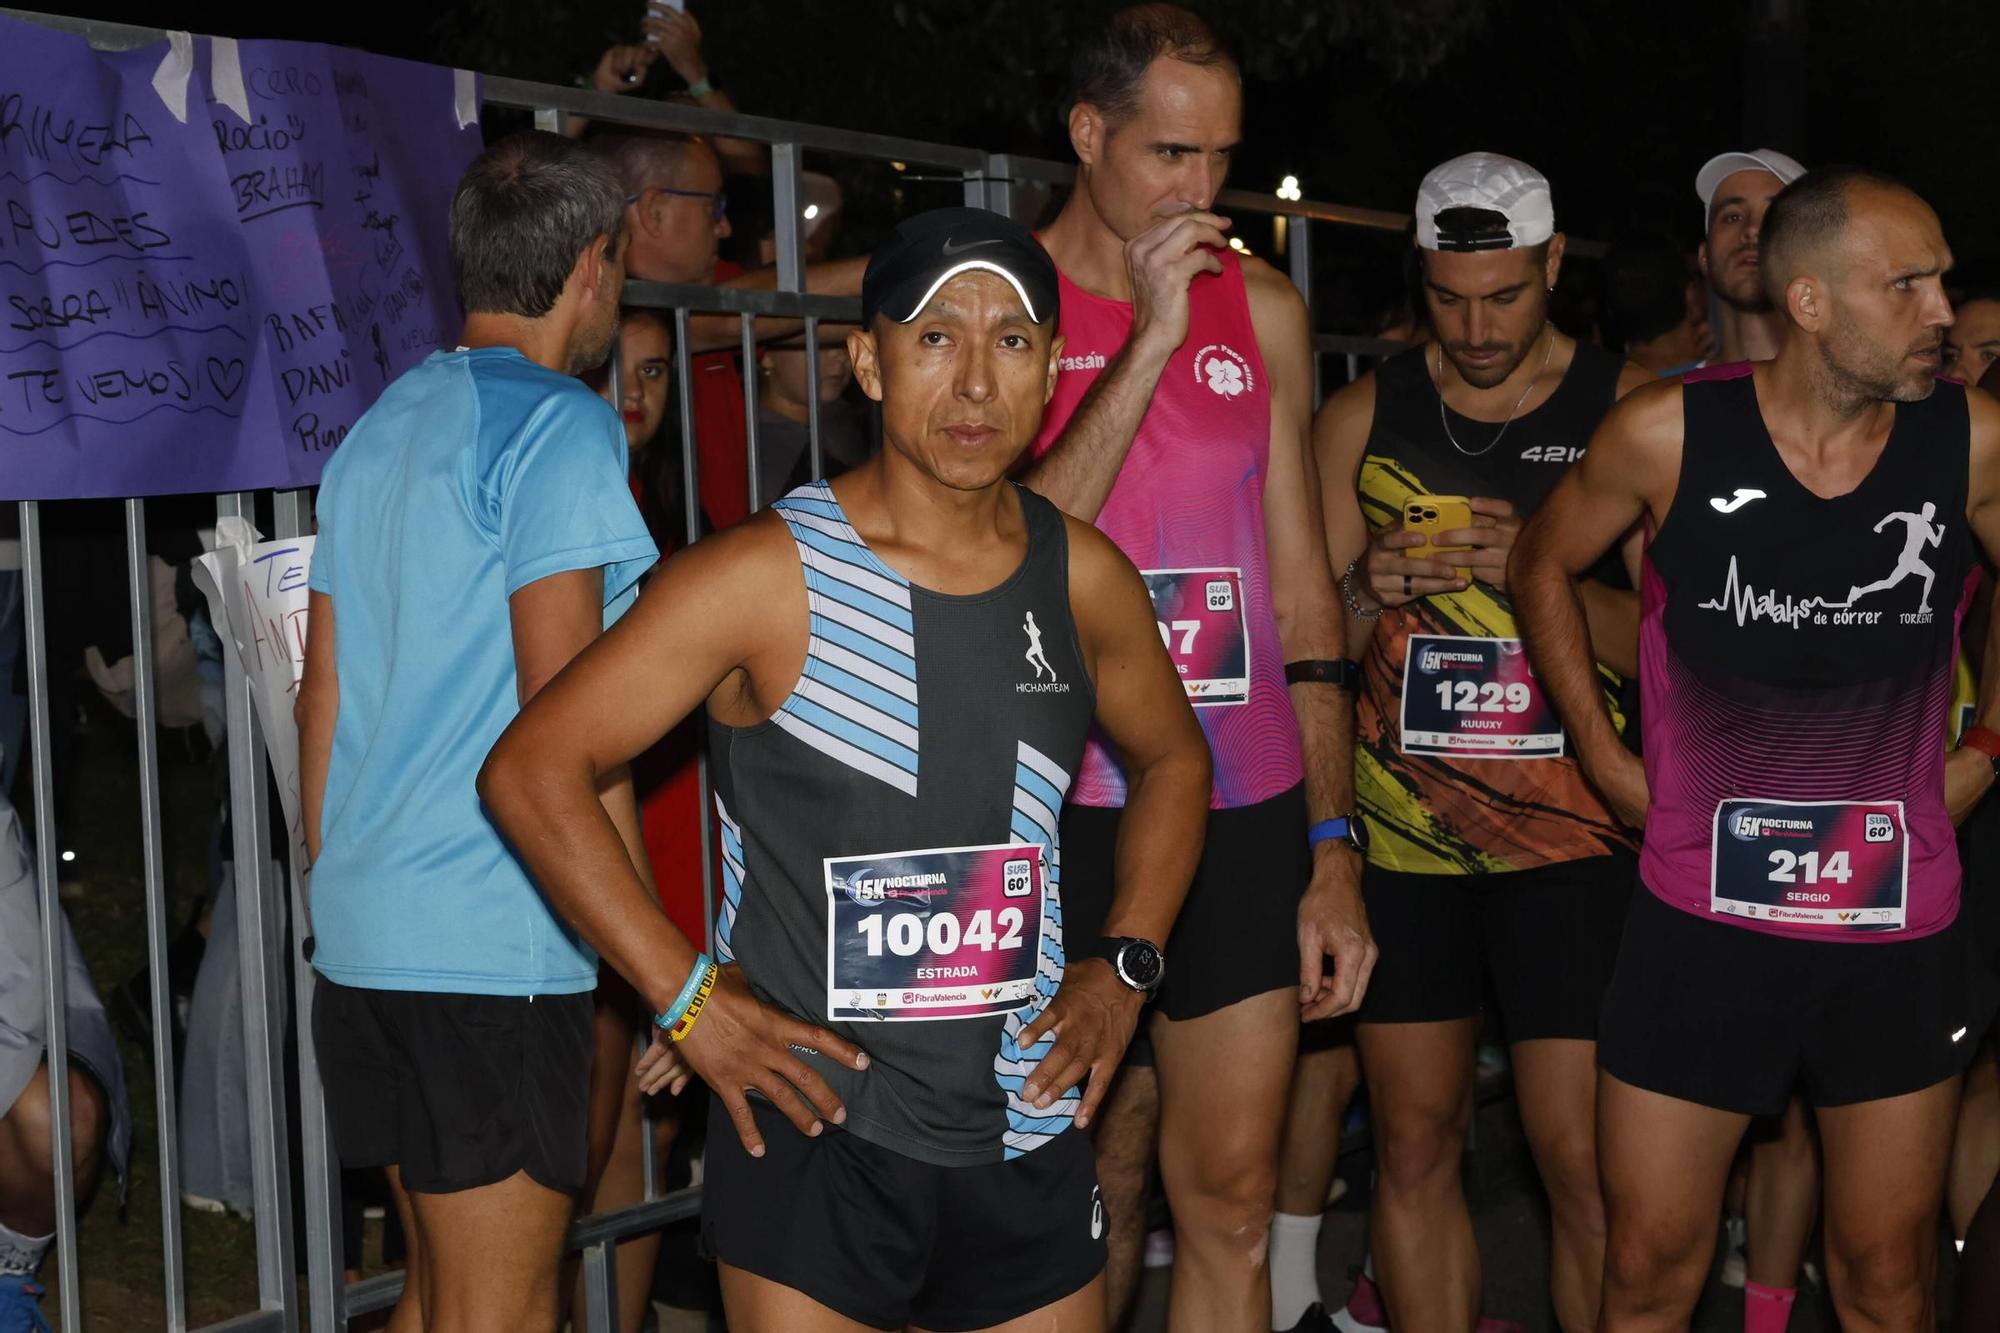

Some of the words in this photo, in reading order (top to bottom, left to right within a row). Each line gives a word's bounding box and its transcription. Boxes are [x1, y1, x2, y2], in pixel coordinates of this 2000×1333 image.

[8, 368, 64, 413] TE
[253, 548, 307, 598] TE
[1208, 585, 1230, 594] SUB
[1814, 611, 1828, 625] de
[1899, 613, 1933, 625] TORRENT
[1421, 651, 1443, 670] 15K
[1442, 651, 1484, 663] NOCTURNA
[1015, 682, 1070, 693] HICHAMTEAM
[1435, 680, 1531, 714] 1229
[1460, 719, 1503, 729] KUUUXY
[1734, 815, 1762, 837] 15K
[1761, 818, 1813, 830] NOCTURNA
[1868, 816, 1890, 825] SUB
[1767, 849, 1853, 885] 214
[855, 878, 887, 900] 15K
[886, 872, 947, 888] NOCTURNA
[1786, 891, 1831, 903] SERGIO
[1778, 909, 1824, 921] FibraValencia
[858, 906, 1024, 956] 10042
[916, 965, 978, 979] ESTRADA
[914, 992, 967, 1003] FibraValencia
